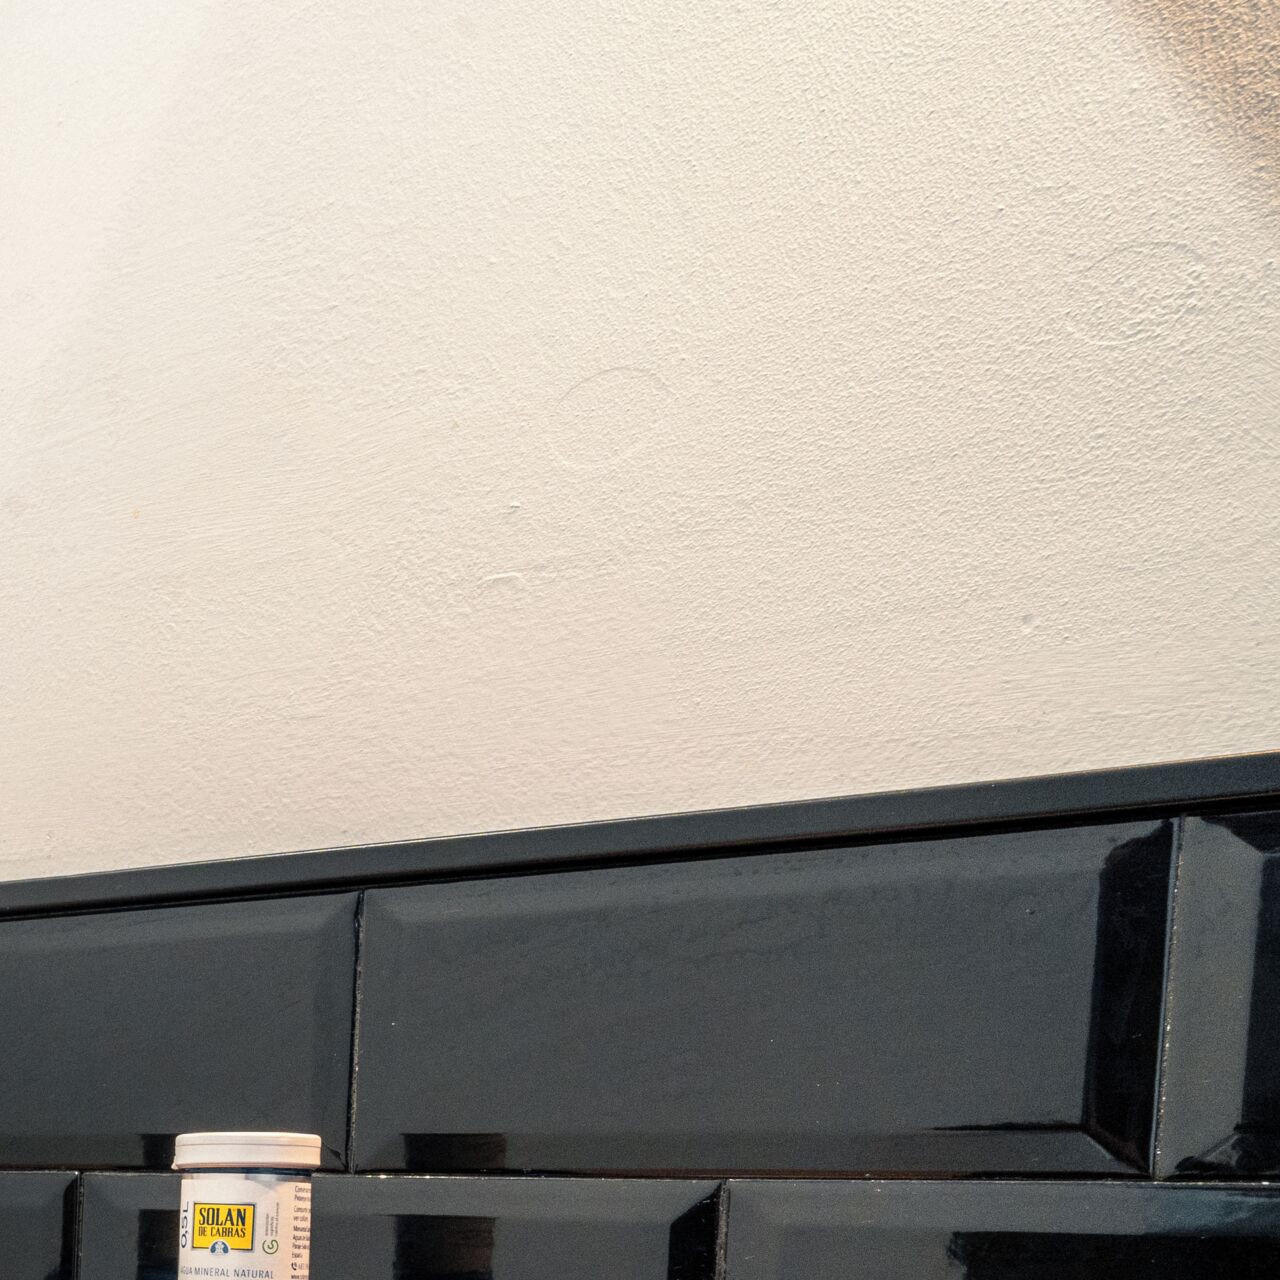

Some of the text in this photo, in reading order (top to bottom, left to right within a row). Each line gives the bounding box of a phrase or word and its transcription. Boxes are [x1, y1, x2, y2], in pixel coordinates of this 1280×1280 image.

[198, 1207, 247, 1227] SOLAN
[198, 1226, 246, 1238] DE CABRAS
[194, 1266, 230, 1277] MINERAL
[233, 1269, 274, 1279] NATURAL
